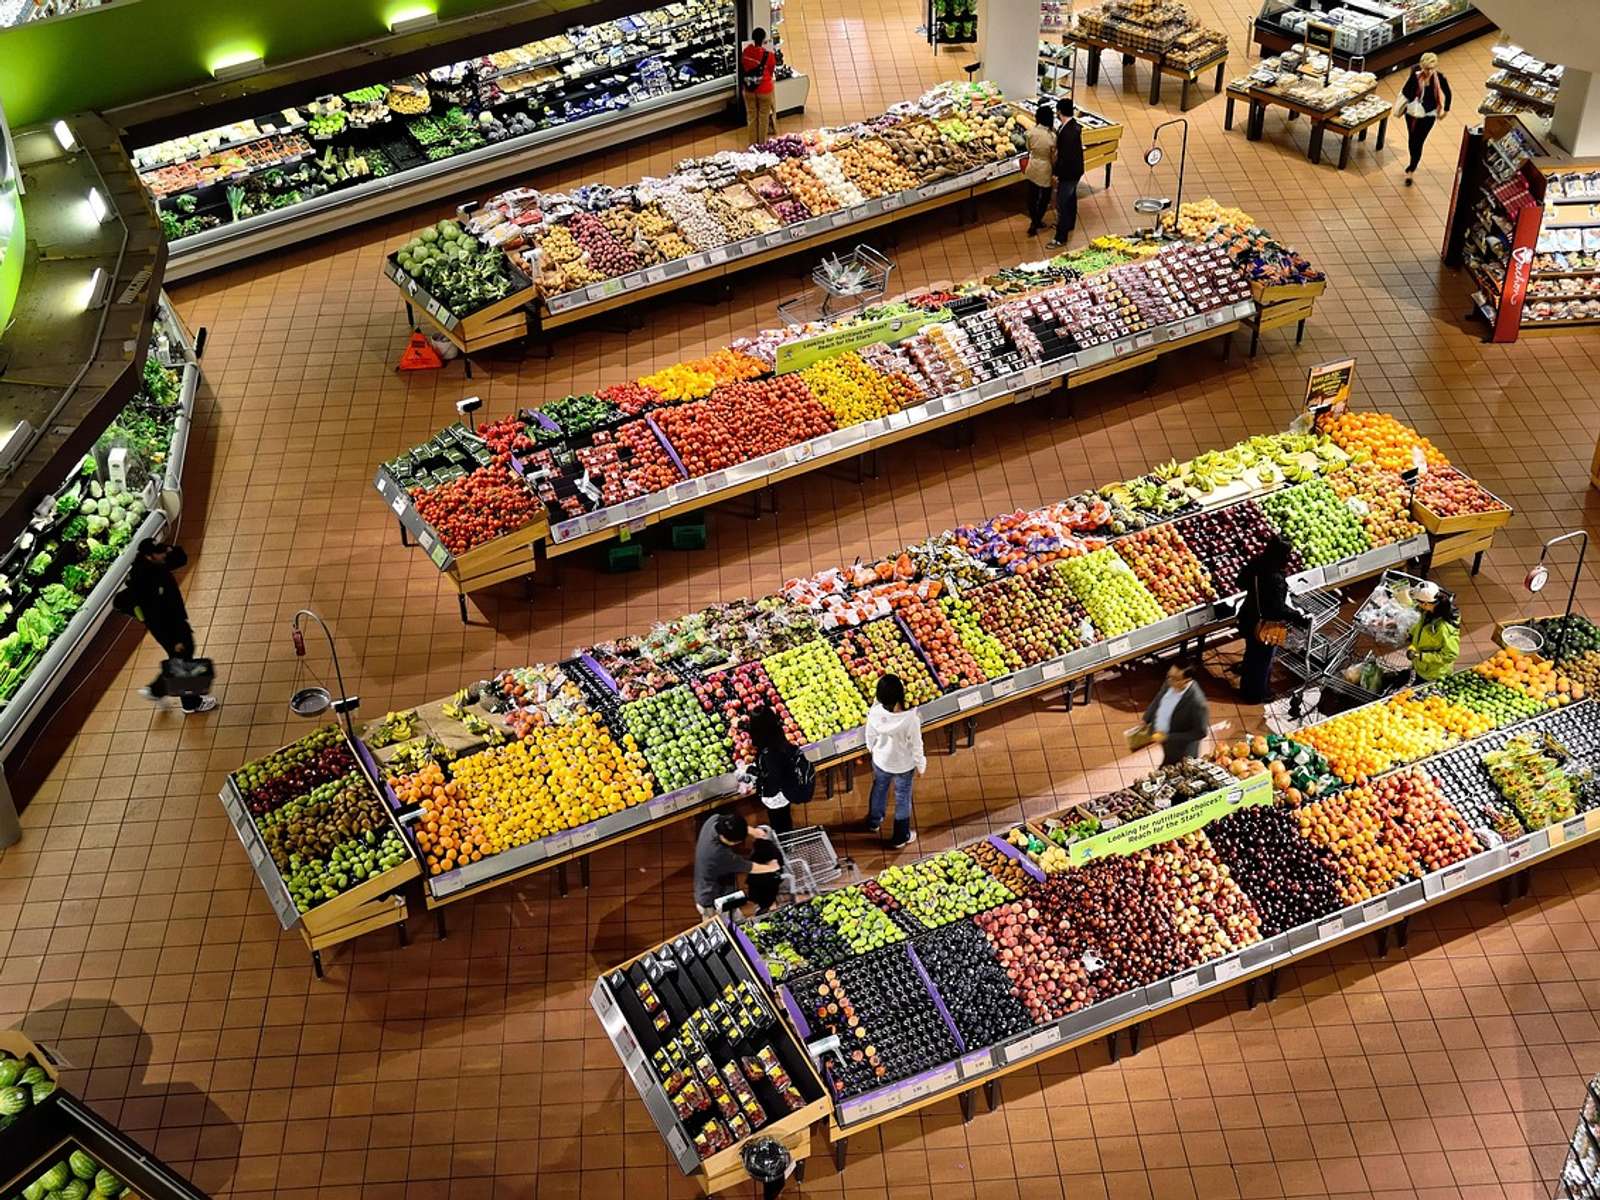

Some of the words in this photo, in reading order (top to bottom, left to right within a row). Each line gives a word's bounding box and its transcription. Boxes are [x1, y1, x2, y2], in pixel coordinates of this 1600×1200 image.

[803, 339, 825, 349] Looking
[1107, 828, 1138, 843] Looking
[1139, 822, 1150, 832] for
[1151, 809, 1189, 826] nutritious
[1190, 794, 1223, 812] choices?
[1128, 830, 1152, 843] Reach
[1152, 824, 1165, 834] for
[1166, 819, 1179, 829] the
